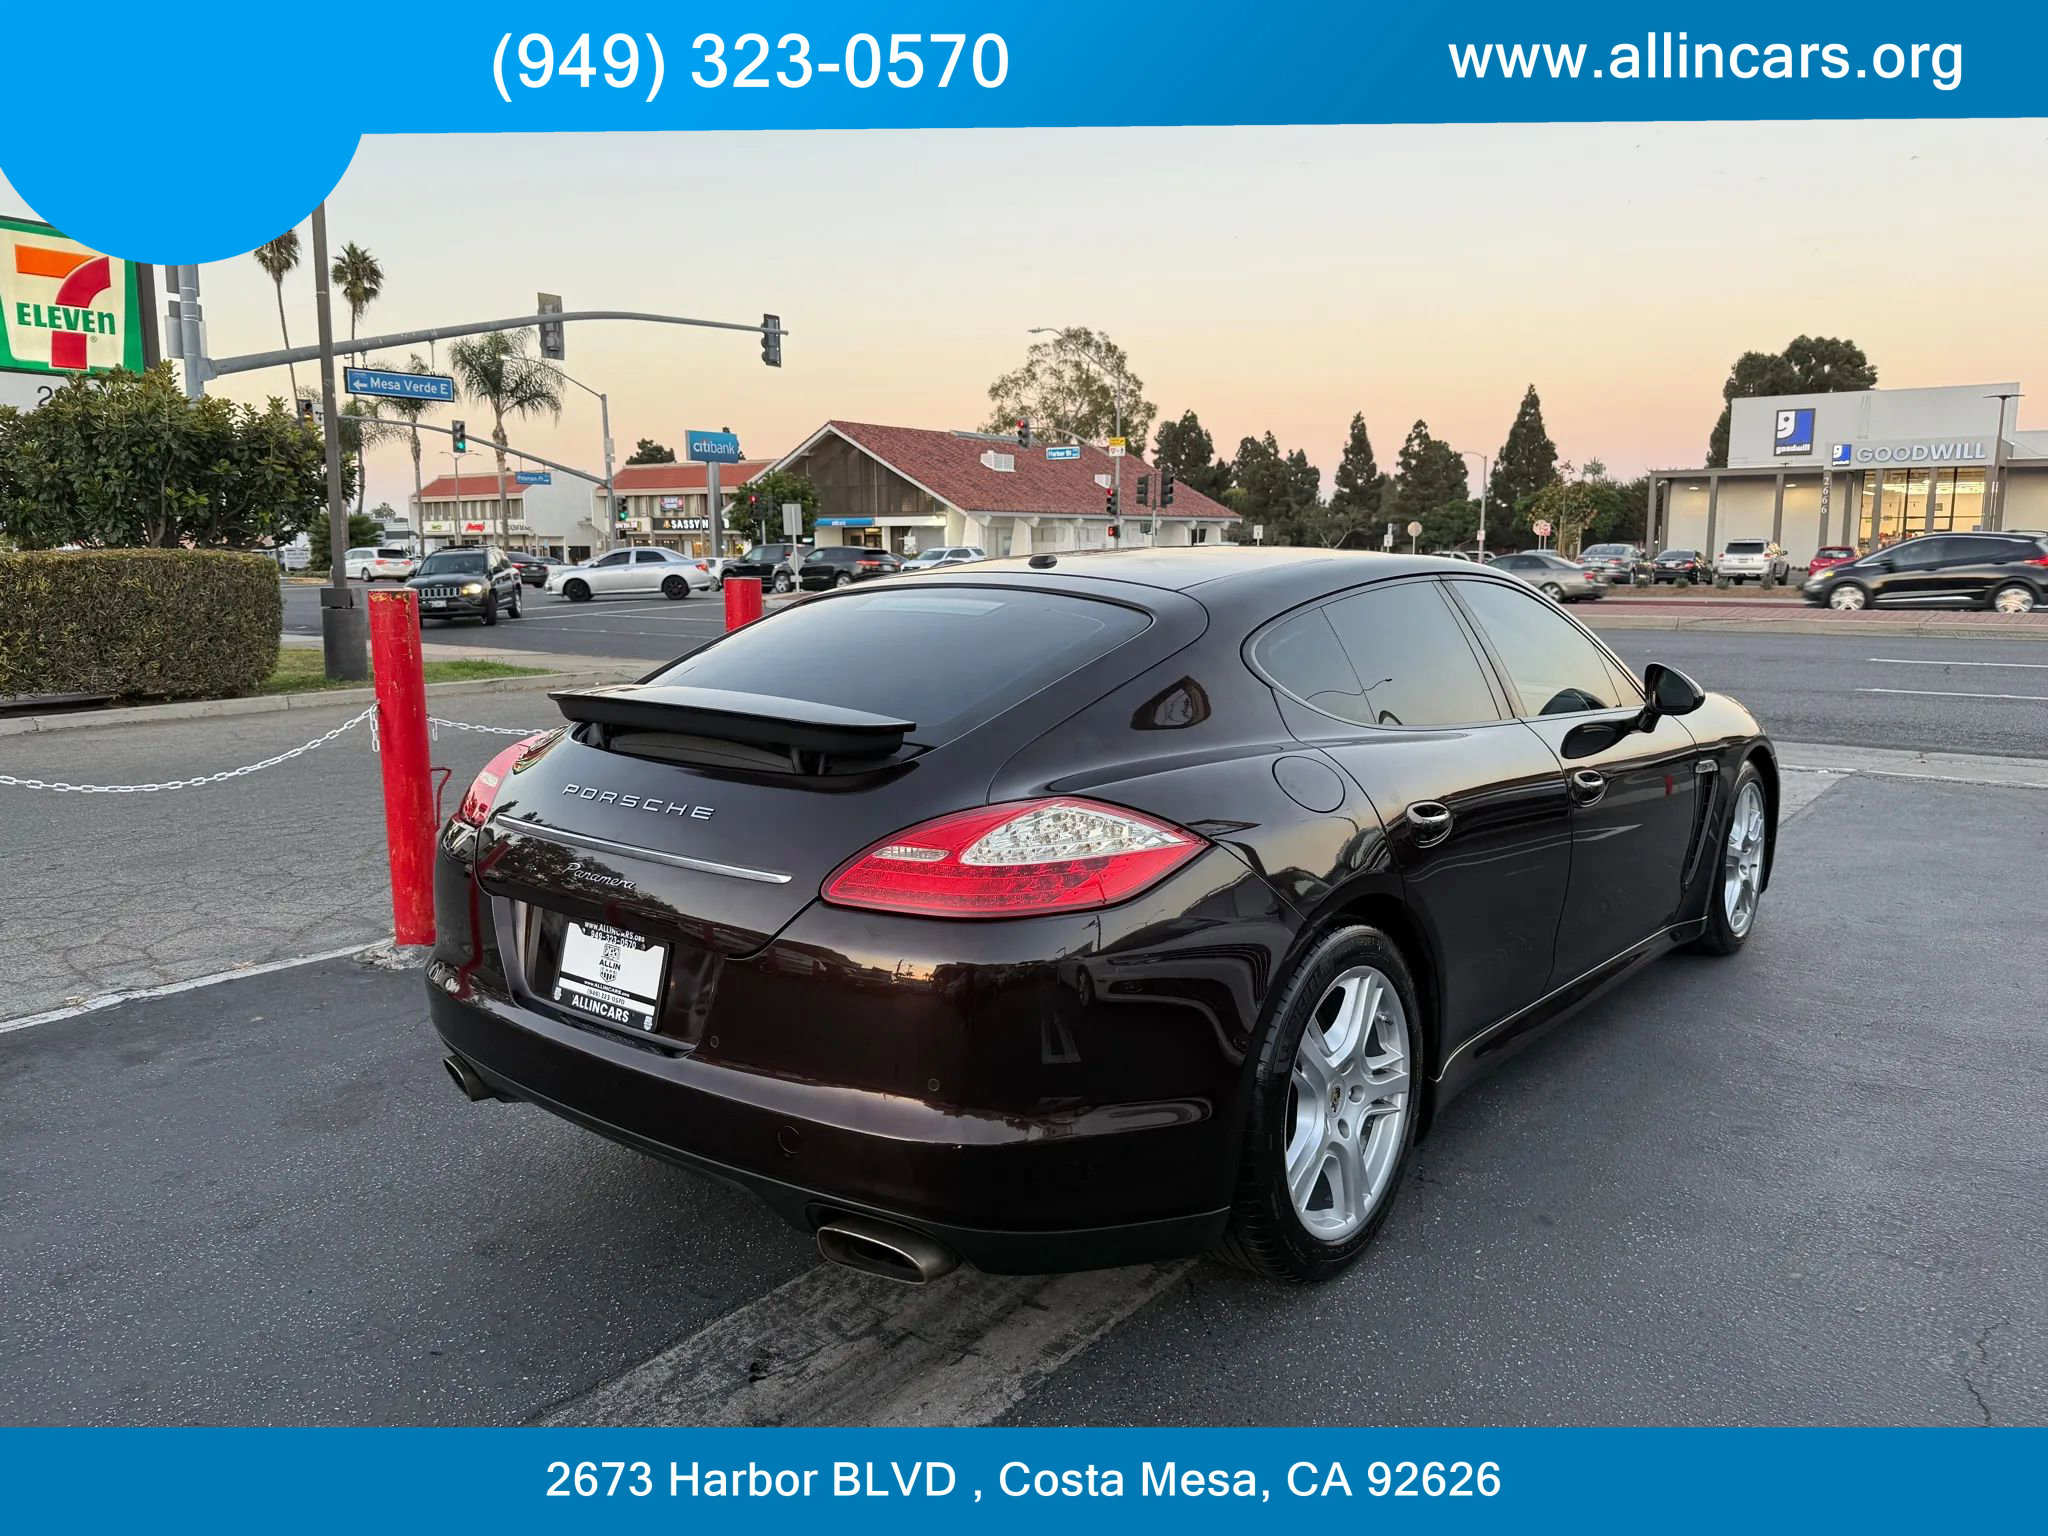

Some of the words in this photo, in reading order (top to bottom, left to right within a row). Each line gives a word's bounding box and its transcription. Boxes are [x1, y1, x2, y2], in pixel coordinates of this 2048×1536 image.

[370, 376, 400, 390] Mesa
[404, 380, 437, 394] Verde
[440, 383, 449, 395] E
[693, 439, 735, 455] citibank
[1775, 443, 1811, 455] goodwill
[1856, 442, 1986, 462] GOODWILL
[1821, 477, 1830, 514] 2666
[671, 519, 700, 529] SASSY
[562, 783, 715, 820] PORSCHE
[562, 862, 637, 890] Panamera
[590, 930, 637, 950] 949-323-0570
[599, 959, 621, 971] ALLIN
[572, 994, 630, 1023] ALLINCARS
